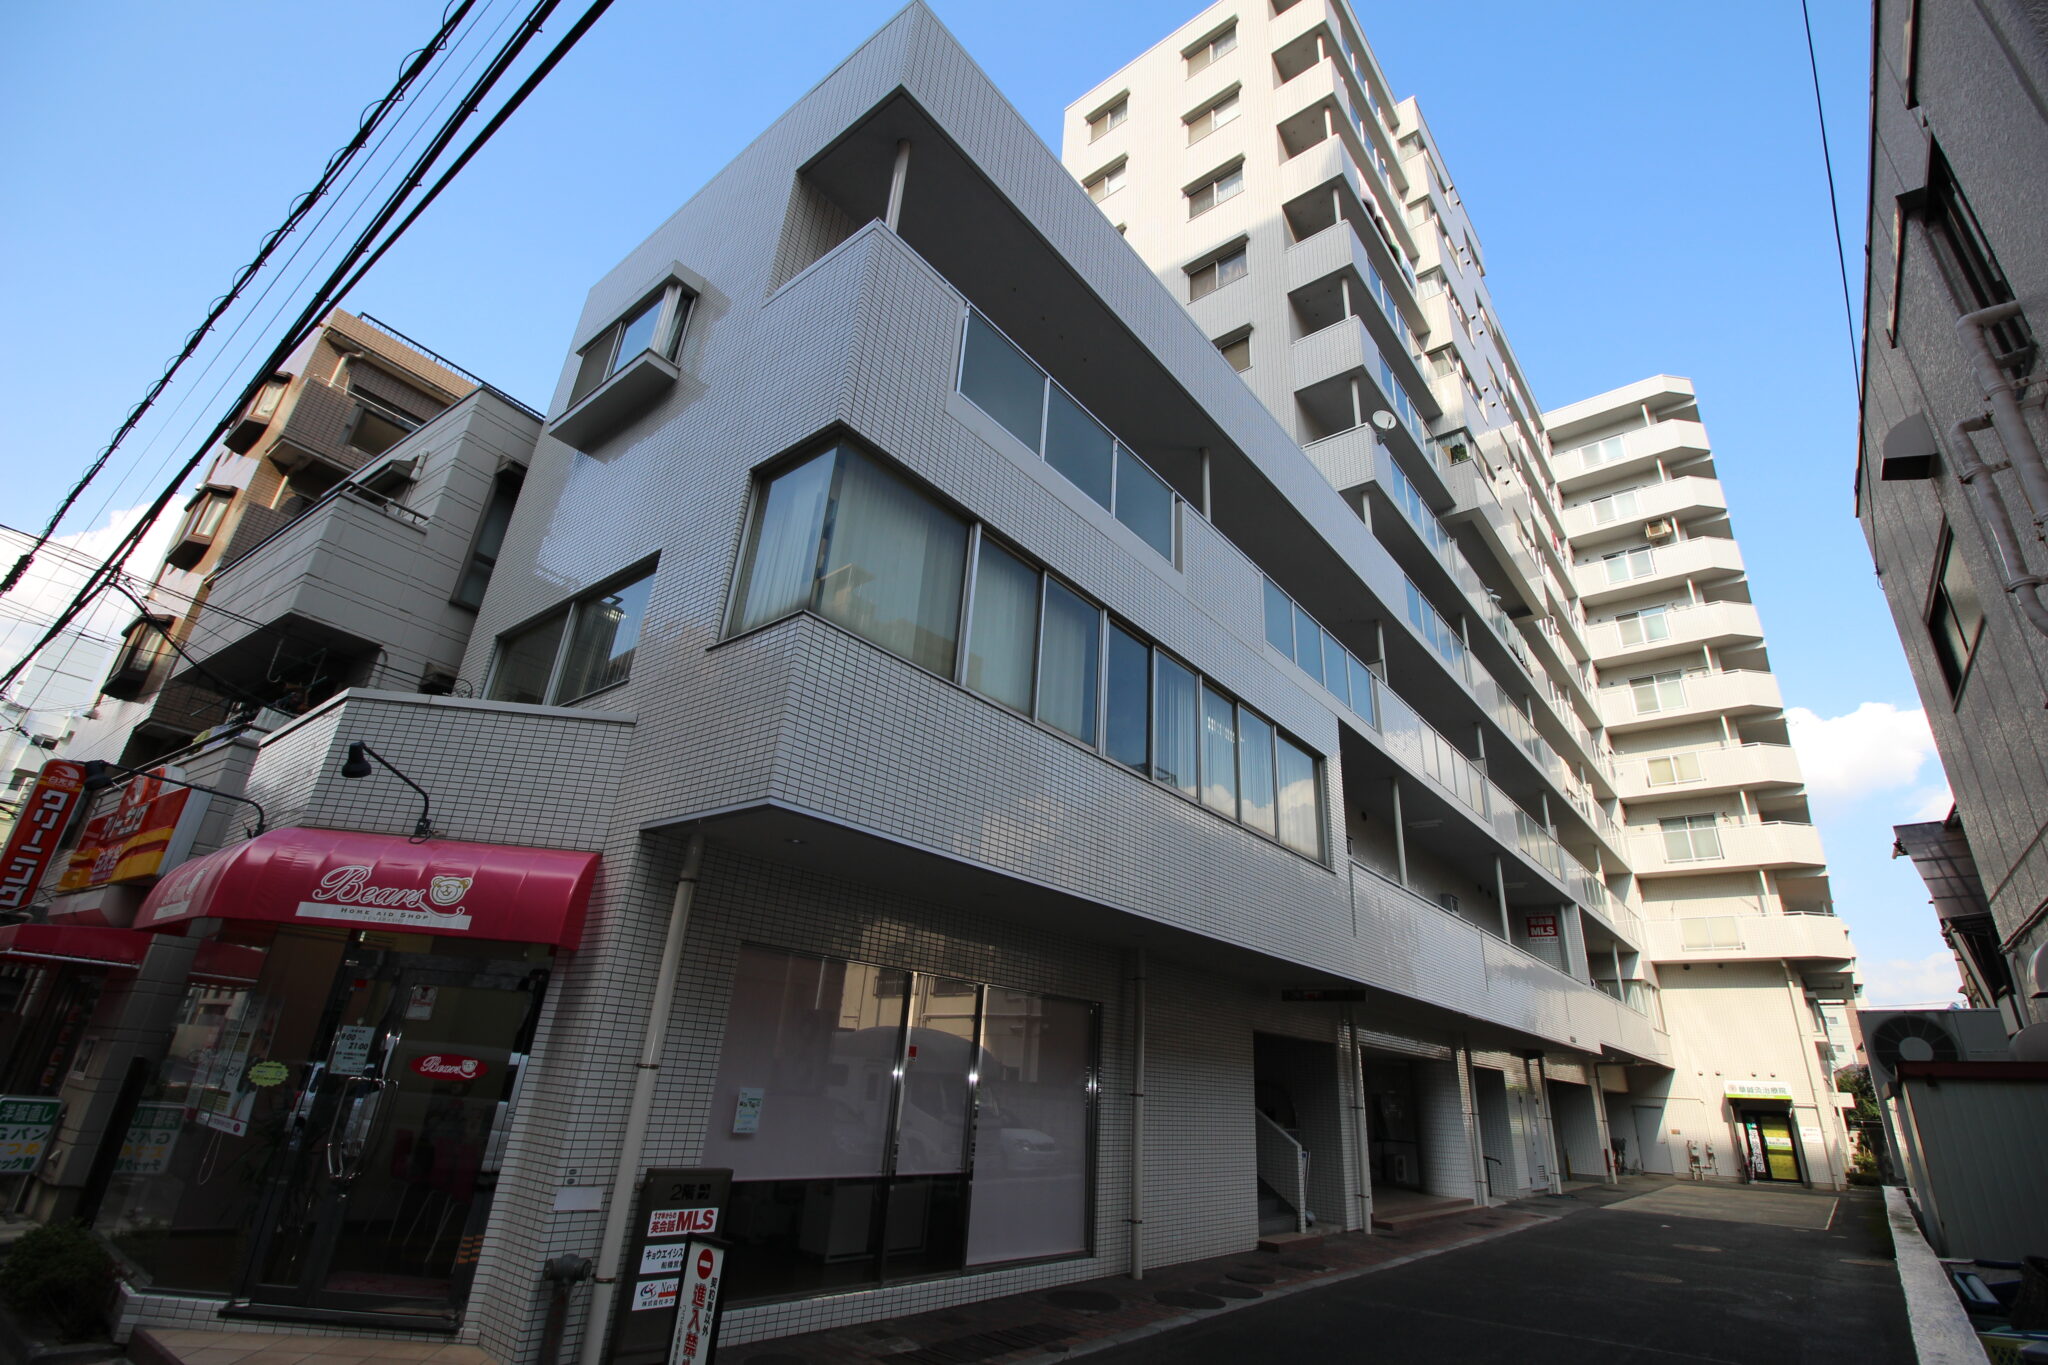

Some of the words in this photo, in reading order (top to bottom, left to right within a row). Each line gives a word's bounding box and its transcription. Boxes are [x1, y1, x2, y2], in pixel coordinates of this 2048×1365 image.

[0, 789, 70, 907] クリーニング
[312, 864, 432, 909] Bears
[1530, 926, 1556, 936] MLS
[0, 1142, 41, 1155] つめ
[650, 1221, 676, 1233] 英会話
[675, 1209, 714, 1232] MLS
[645, 1247, 684, 1260] キョウエイシス
[681, 1282, 708, 1365] 進入禁
